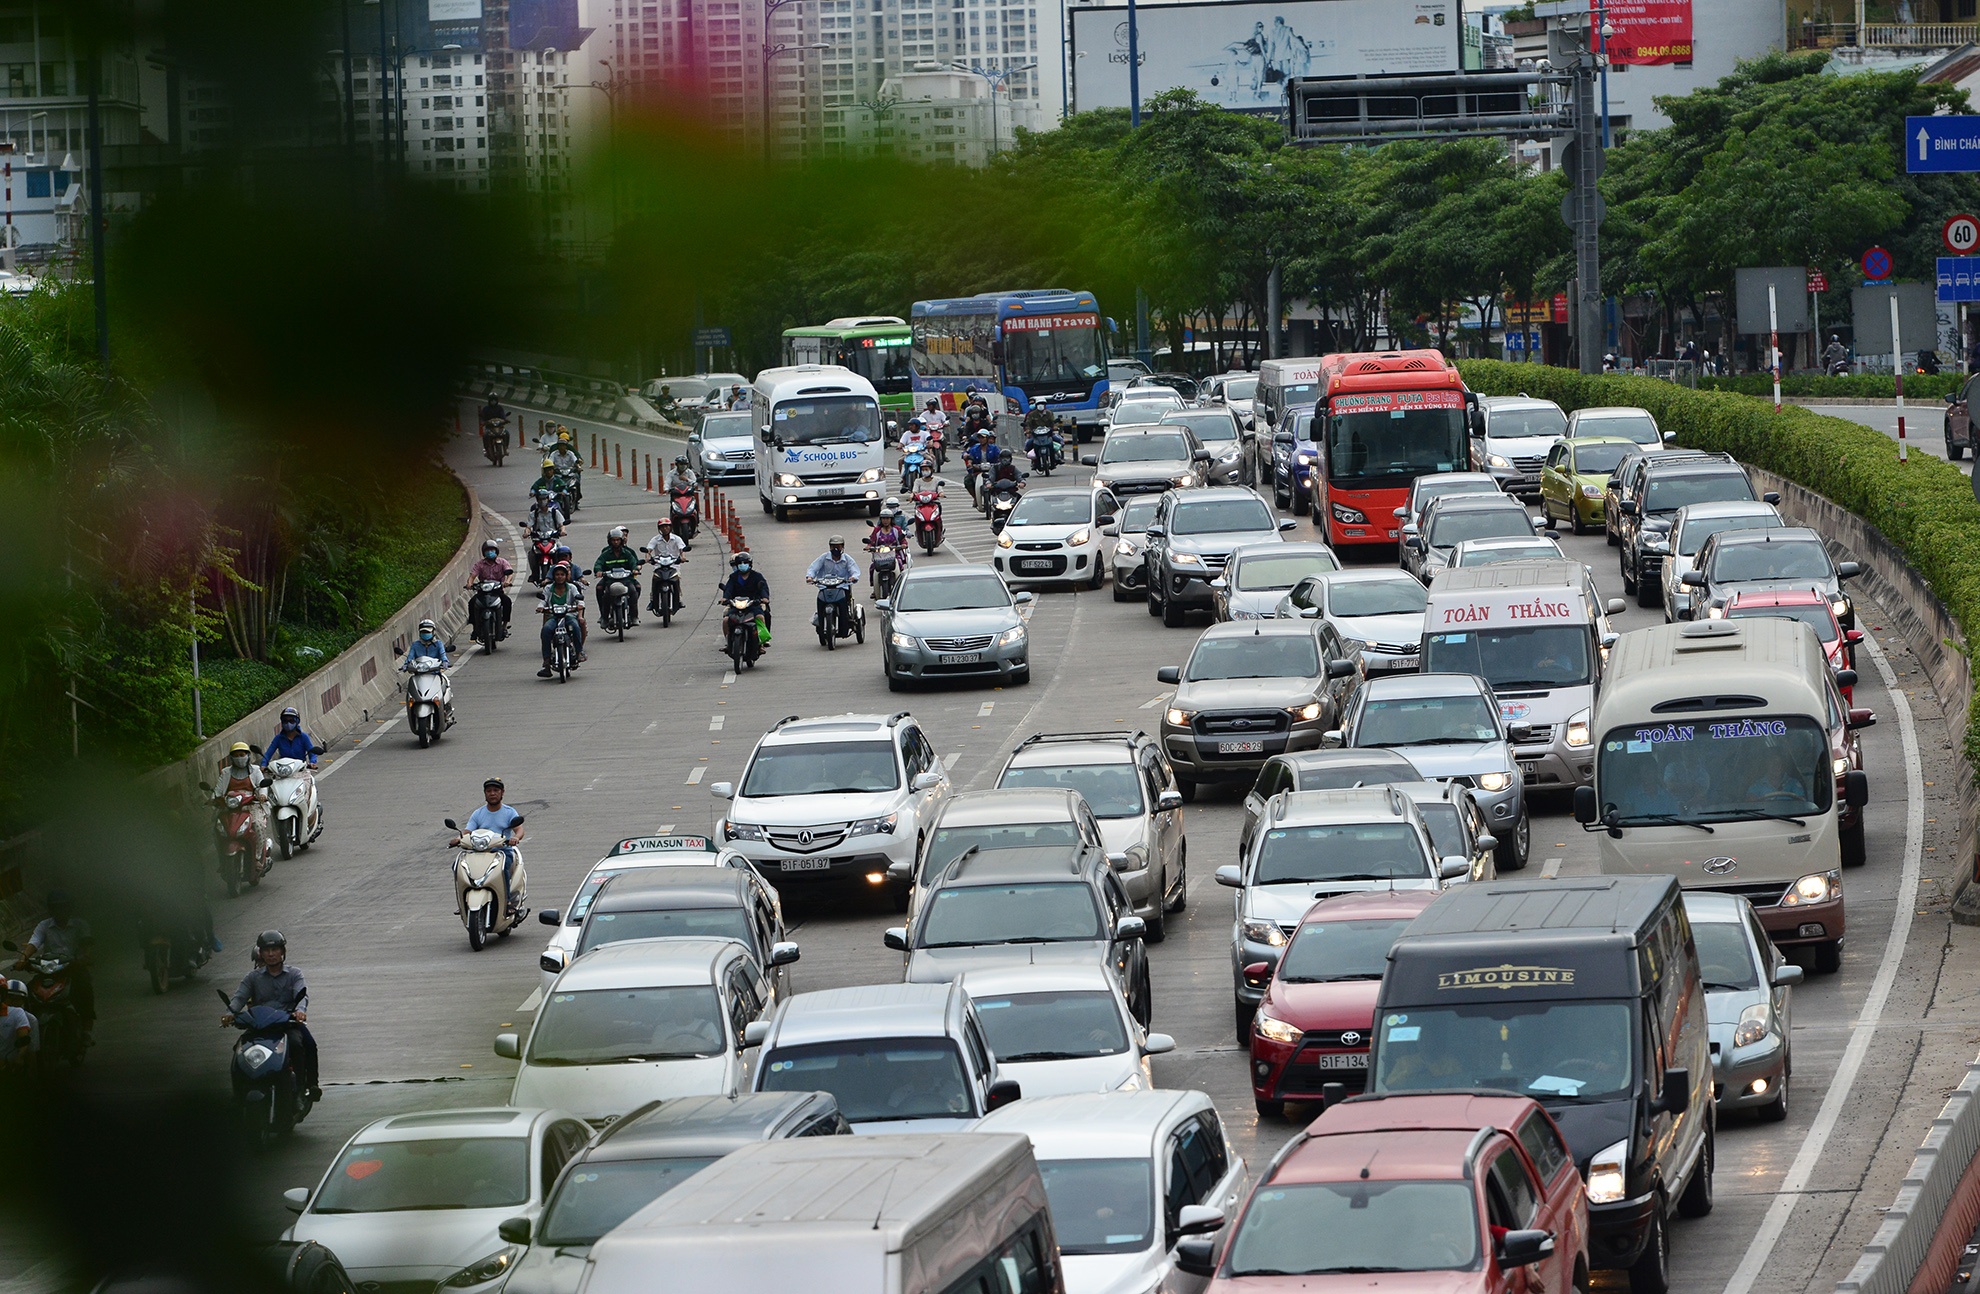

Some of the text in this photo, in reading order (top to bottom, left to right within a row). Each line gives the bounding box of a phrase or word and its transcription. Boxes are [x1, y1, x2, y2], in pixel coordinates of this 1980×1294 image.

[1935, 136, 1957, 150] BÌNH
[1954, 225, 1971, 243] 60
[1053, 316, 1097, 327] Travel
[1397, 393, 1424, 403] FUTA
[1426, 393, 1440, 402] Bus
[1441, 392, 1460, 402] Lines
[803, 450, 857, 462] SCHOOL BUS
[1443, 603, 1491, 624] TOÀN
[1635, 723, 1695, 744] TOÀN
[639, 839, 704, 849] VINASUN TAXI
[1439, 971, 1575, 987] LIMOUSINE
